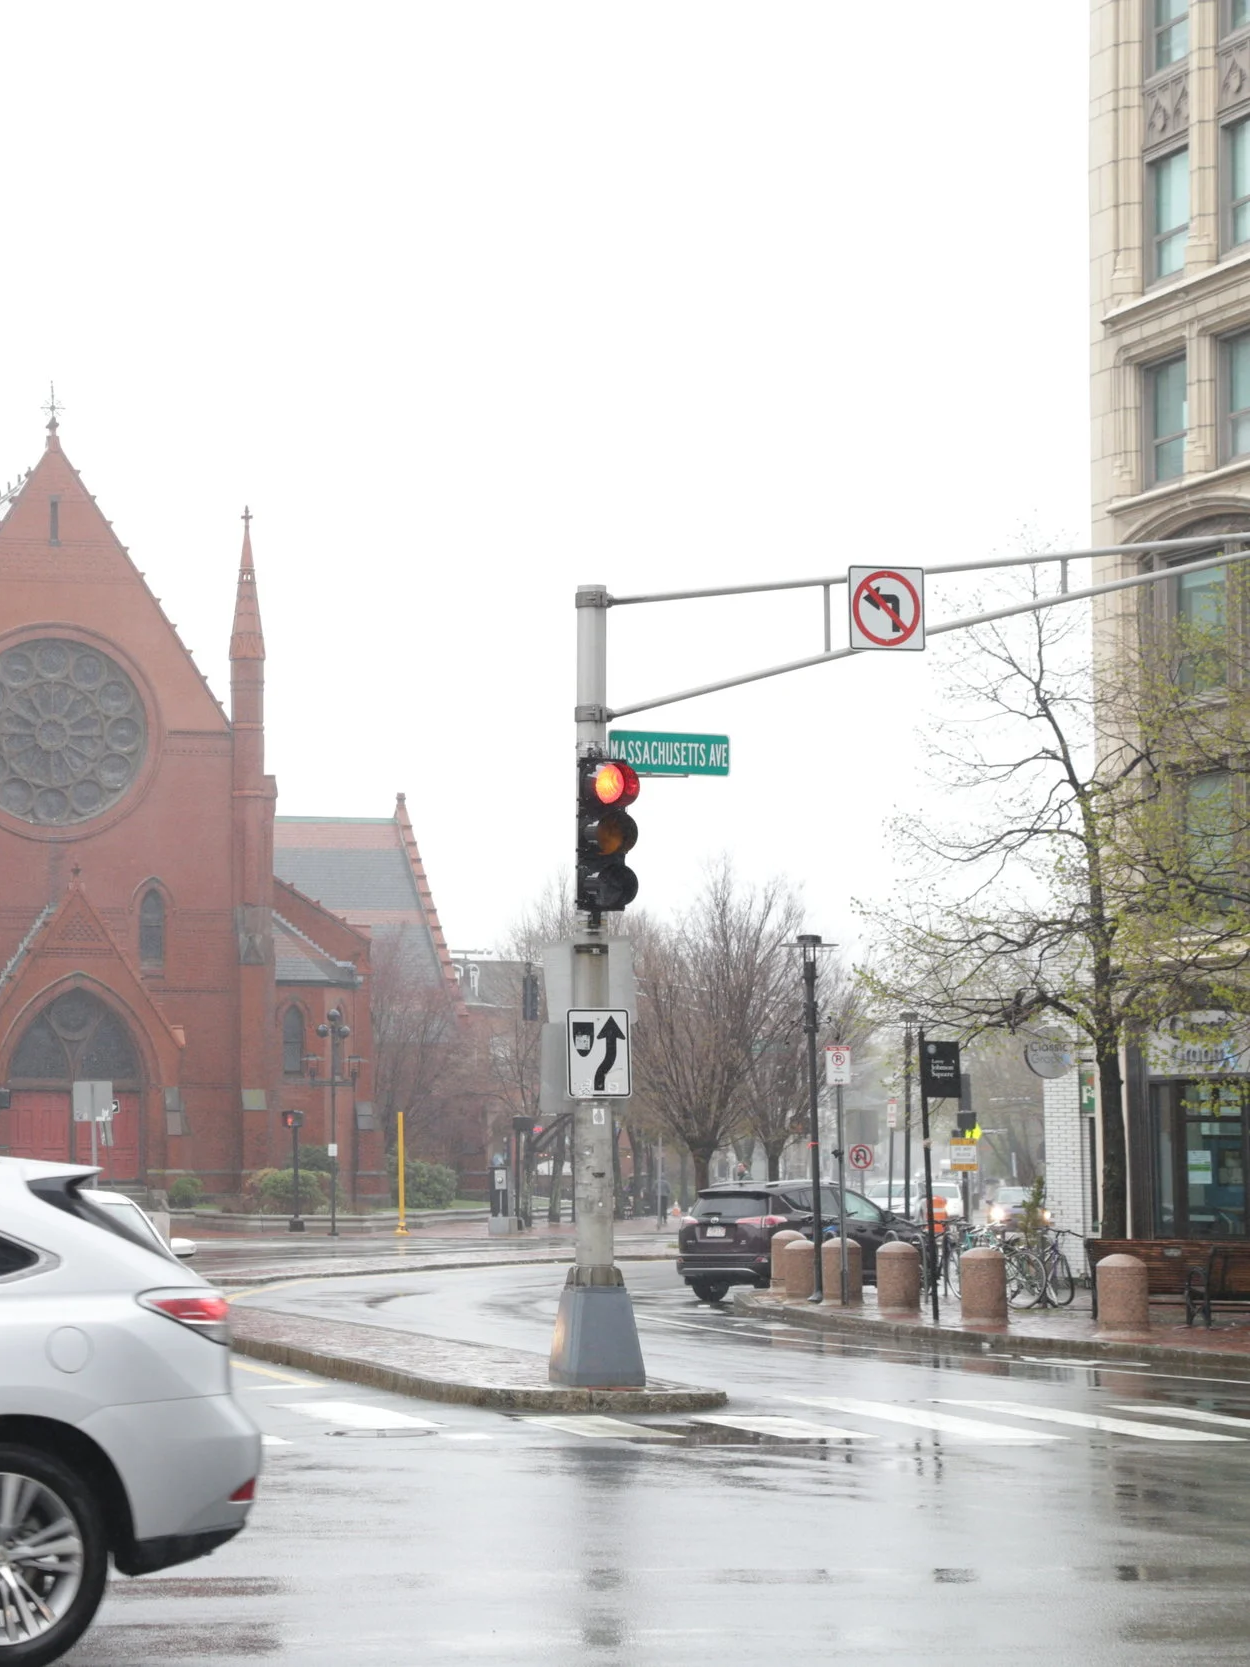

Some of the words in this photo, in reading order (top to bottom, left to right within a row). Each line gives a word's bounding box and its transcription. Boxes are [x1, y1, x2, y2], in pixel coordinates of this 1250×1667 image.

[610, 740, 706, 767] MASSACHUSETTS
[709, 743, 728, 768] AVE
[1029, 1041, 1069, 1052] Classic
